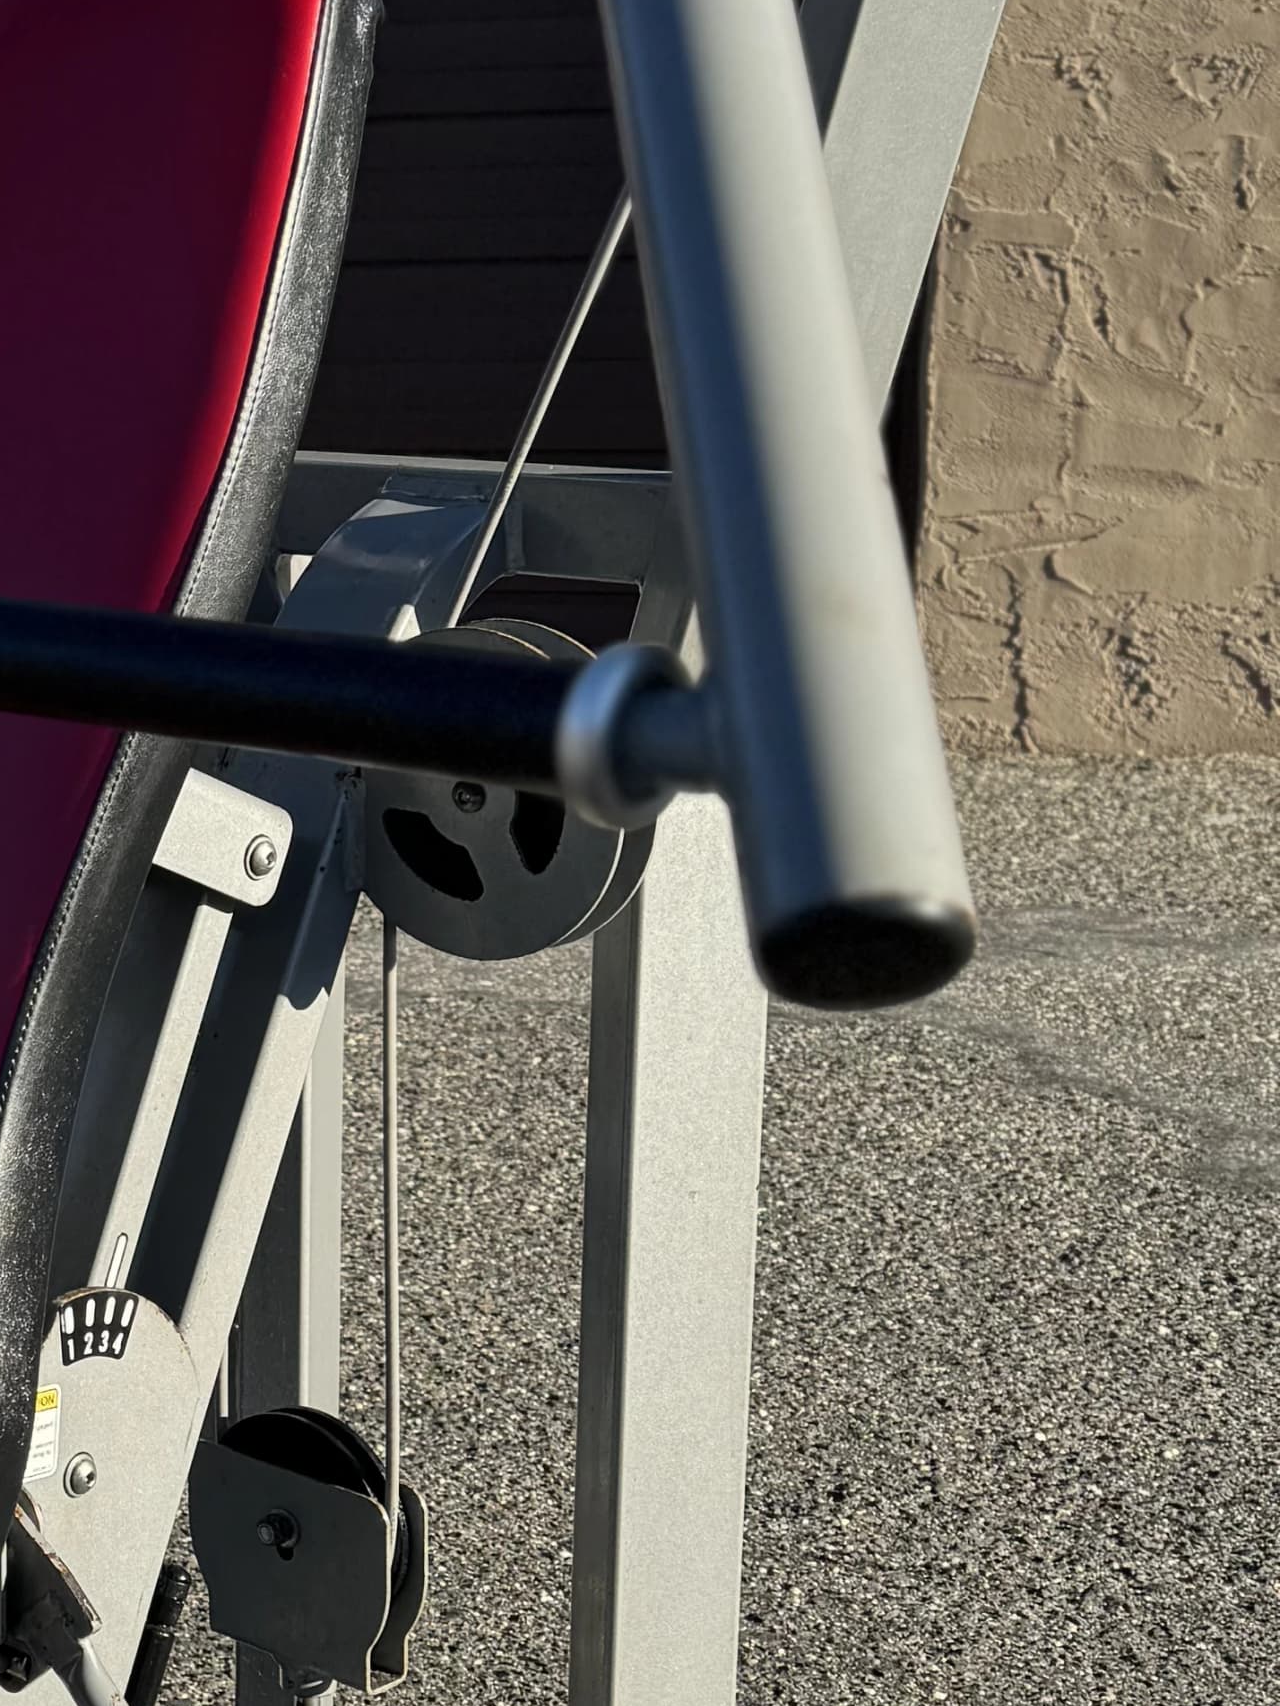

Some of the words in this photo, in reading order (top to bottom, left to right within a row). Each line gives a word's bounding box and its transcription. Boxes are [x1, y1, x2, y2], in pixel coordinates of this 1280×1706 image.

[68, 1338, 74, 1360] 1
[84, 1332, 93, 1355] 2
[99, 1330, 110, 1353] 3
[112, 1332, 123, 1355] 4
